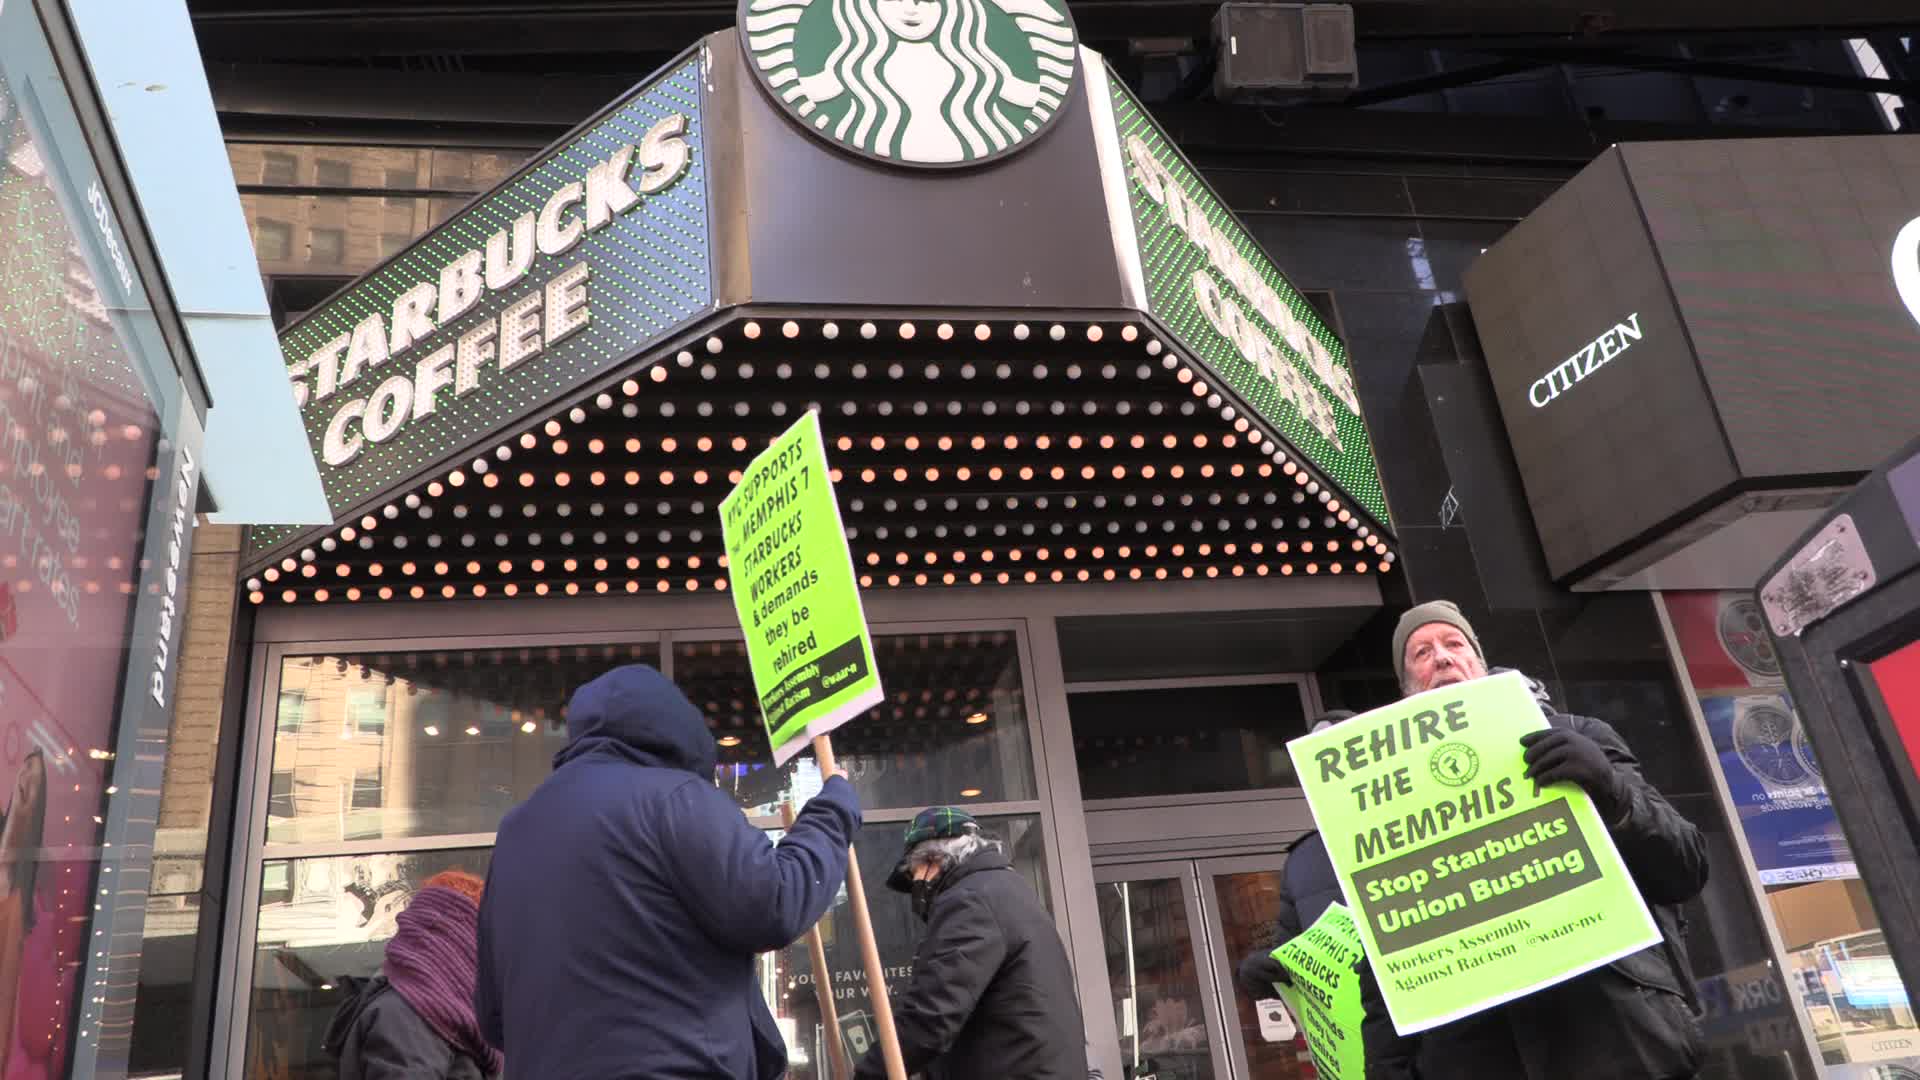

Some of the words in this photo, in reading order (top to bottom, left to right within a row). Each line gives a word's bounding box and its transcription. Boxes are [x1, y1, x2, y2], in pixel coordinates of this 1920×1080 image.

[87, 179, 132, 296] JCDecaux
[322, 261, 590, 467] COFFEE
[1528, 312, 1644, 408] CITIZEN
[742, 476, 799, 544] MEMPHIS
[800, 465, 809, 490] 7
[743, 437, 803, 510] SUPPORTS
[151, 447, 195, 708] Newsstand
[743, 510, 802, 578] STARBUCKS
[750, 544, 802, 604] WORKERS
[752, 609, 762, 629] &
[761, 569, 819, 620] demands
[764, 617, 790, 647] they
[792, 606, 811, 627] be
[773, 630, 818, 675] rehired
[1315, 700, 1470, 783] REHIRE
[1351, 767, 1413, 812] THE
[1355, 777, 1515, 863] MEMPHIS
[1366, 869, 1429, 902] Stop
[1432, 818, 1568, 879] Starbucks
[1377, 890, 1466, 934] Union
[1469, 849, 1585, 903] Busting
[789, 974, 818, 986] YOU
[835, 966, 913, 983] FAVITES
[1282, 943, 1341, 990] STARBUCKS
[1386, 946, 1454, 975] Workers
[1459, 917, 1532, 952] Assembly
[1395, 964, 1453, 993] Against
[1457, 943, 1517, 973] Racism
